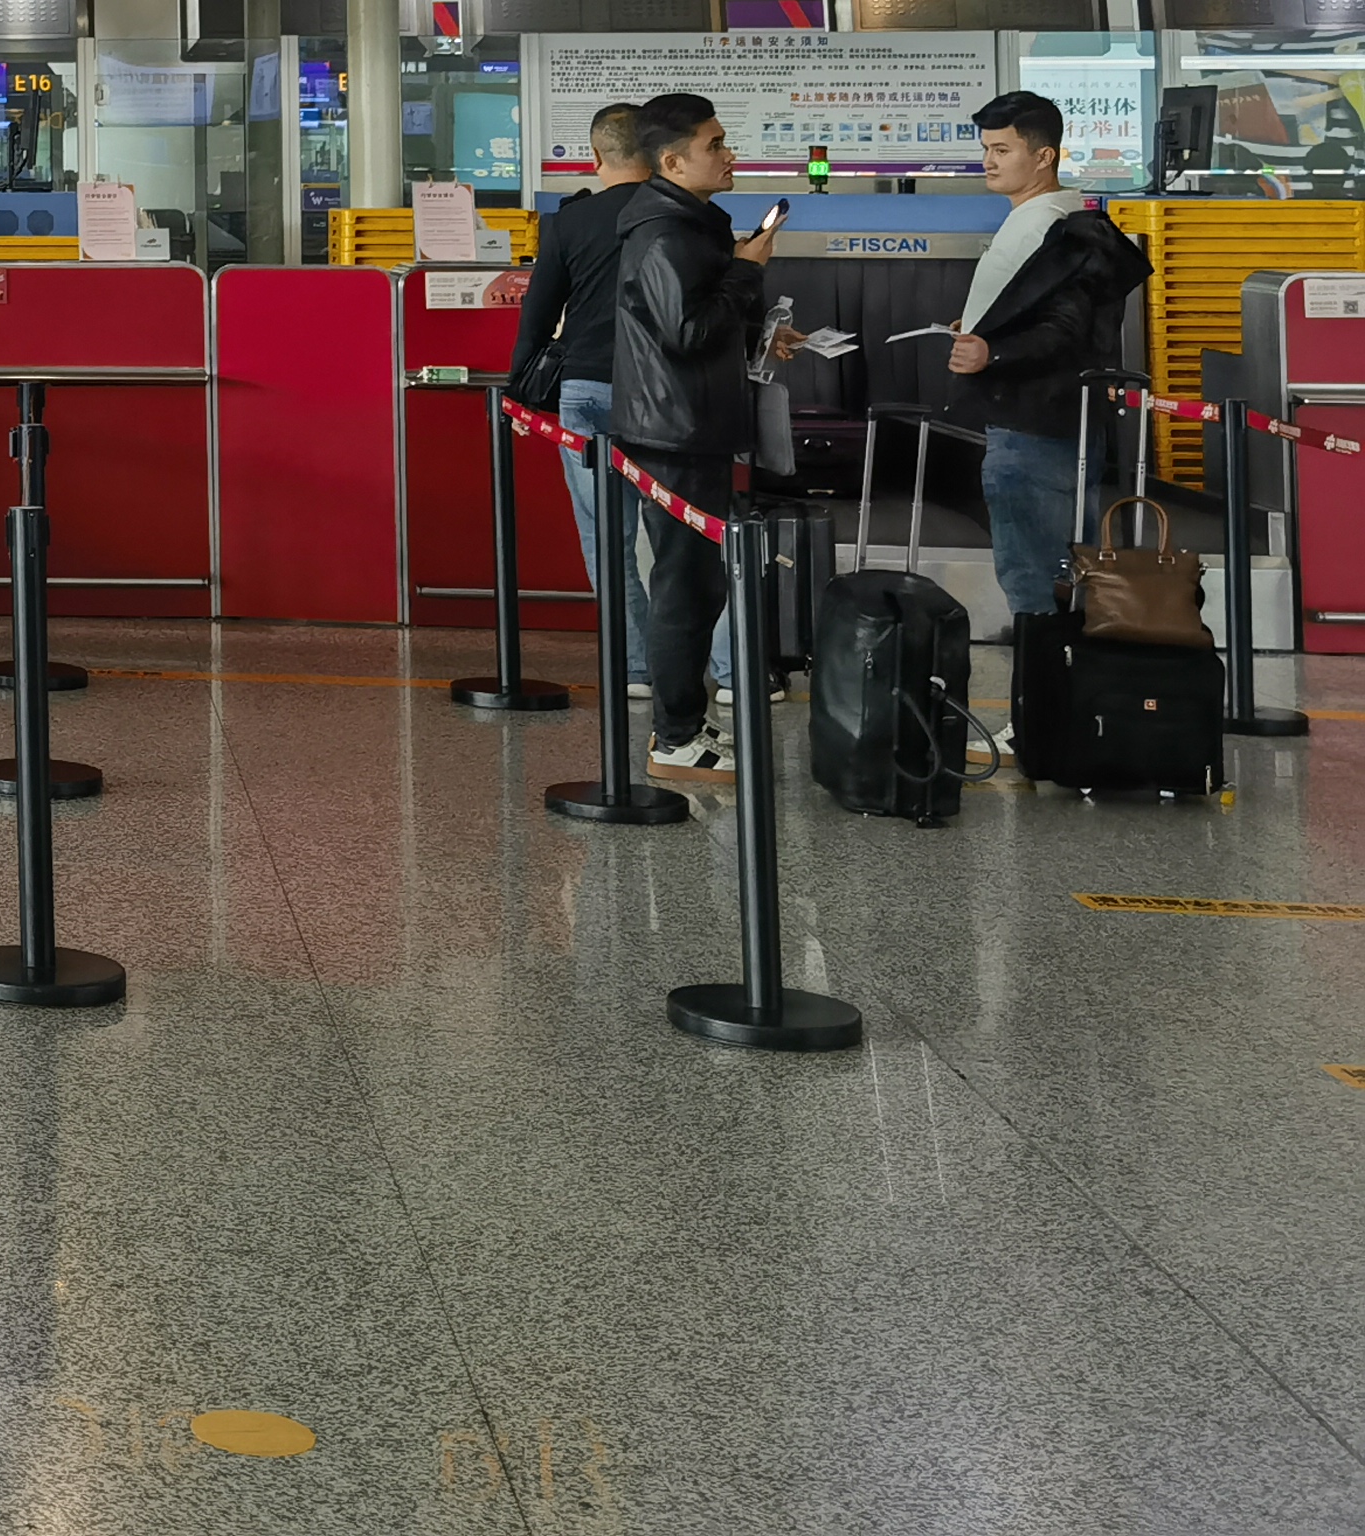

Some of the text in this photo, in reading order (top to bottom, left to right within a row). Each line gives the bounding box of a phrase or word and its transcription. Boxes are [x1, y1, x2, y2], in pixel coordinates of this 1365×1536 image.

[702, 36, 829, 48] 行李运输安全须知
[1051, 97, 1138, 116] 装得体
[848, 237, 928, 252] FISCAN
